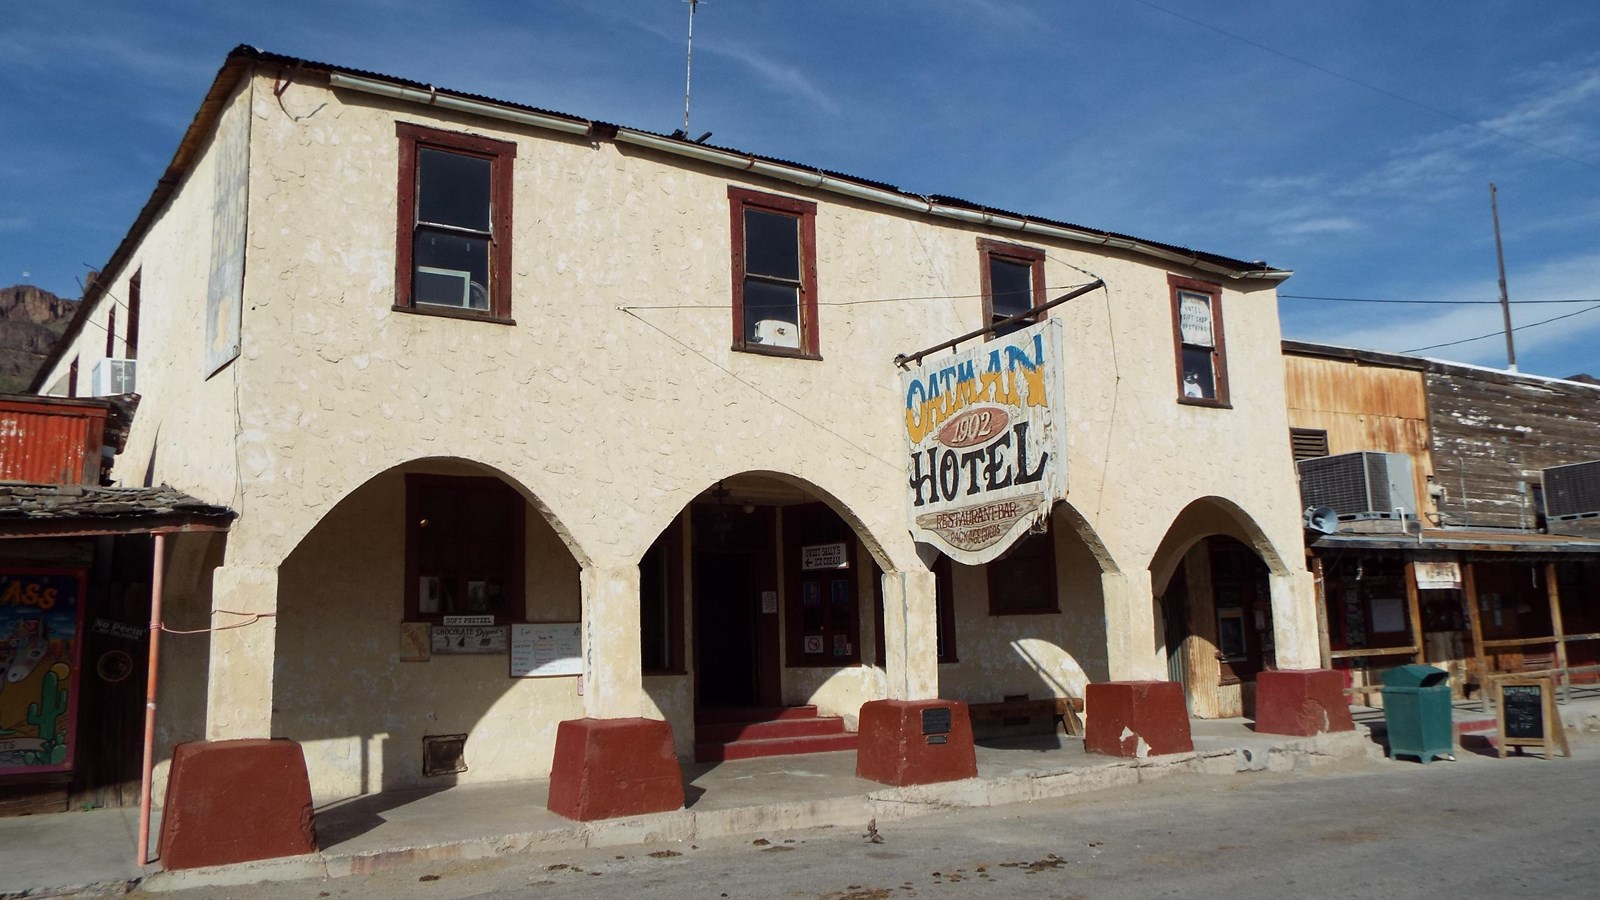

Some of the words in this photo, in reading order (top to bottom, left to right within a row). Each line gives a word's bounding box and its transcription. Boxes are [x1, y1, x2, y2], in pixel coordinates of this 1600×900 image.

[906, 333, 1048, 444] OATMAN
[951, 411, 992, 443] 1902
[909, 420, 1049, 507] HOTEL
[950, 528, 982, 544] PACKAGE
[981, 524, 1001, 542] GOODS
[814, 557, 823, 567] ICE
[0, 578, 58, 609] ASS
[95, 617, 109, 628] No
[446, 617, 463, 625] SOFT
[464, 616, 493, 625] PRETZEL
[436, 628, 474, 637] CHOCOLATE
